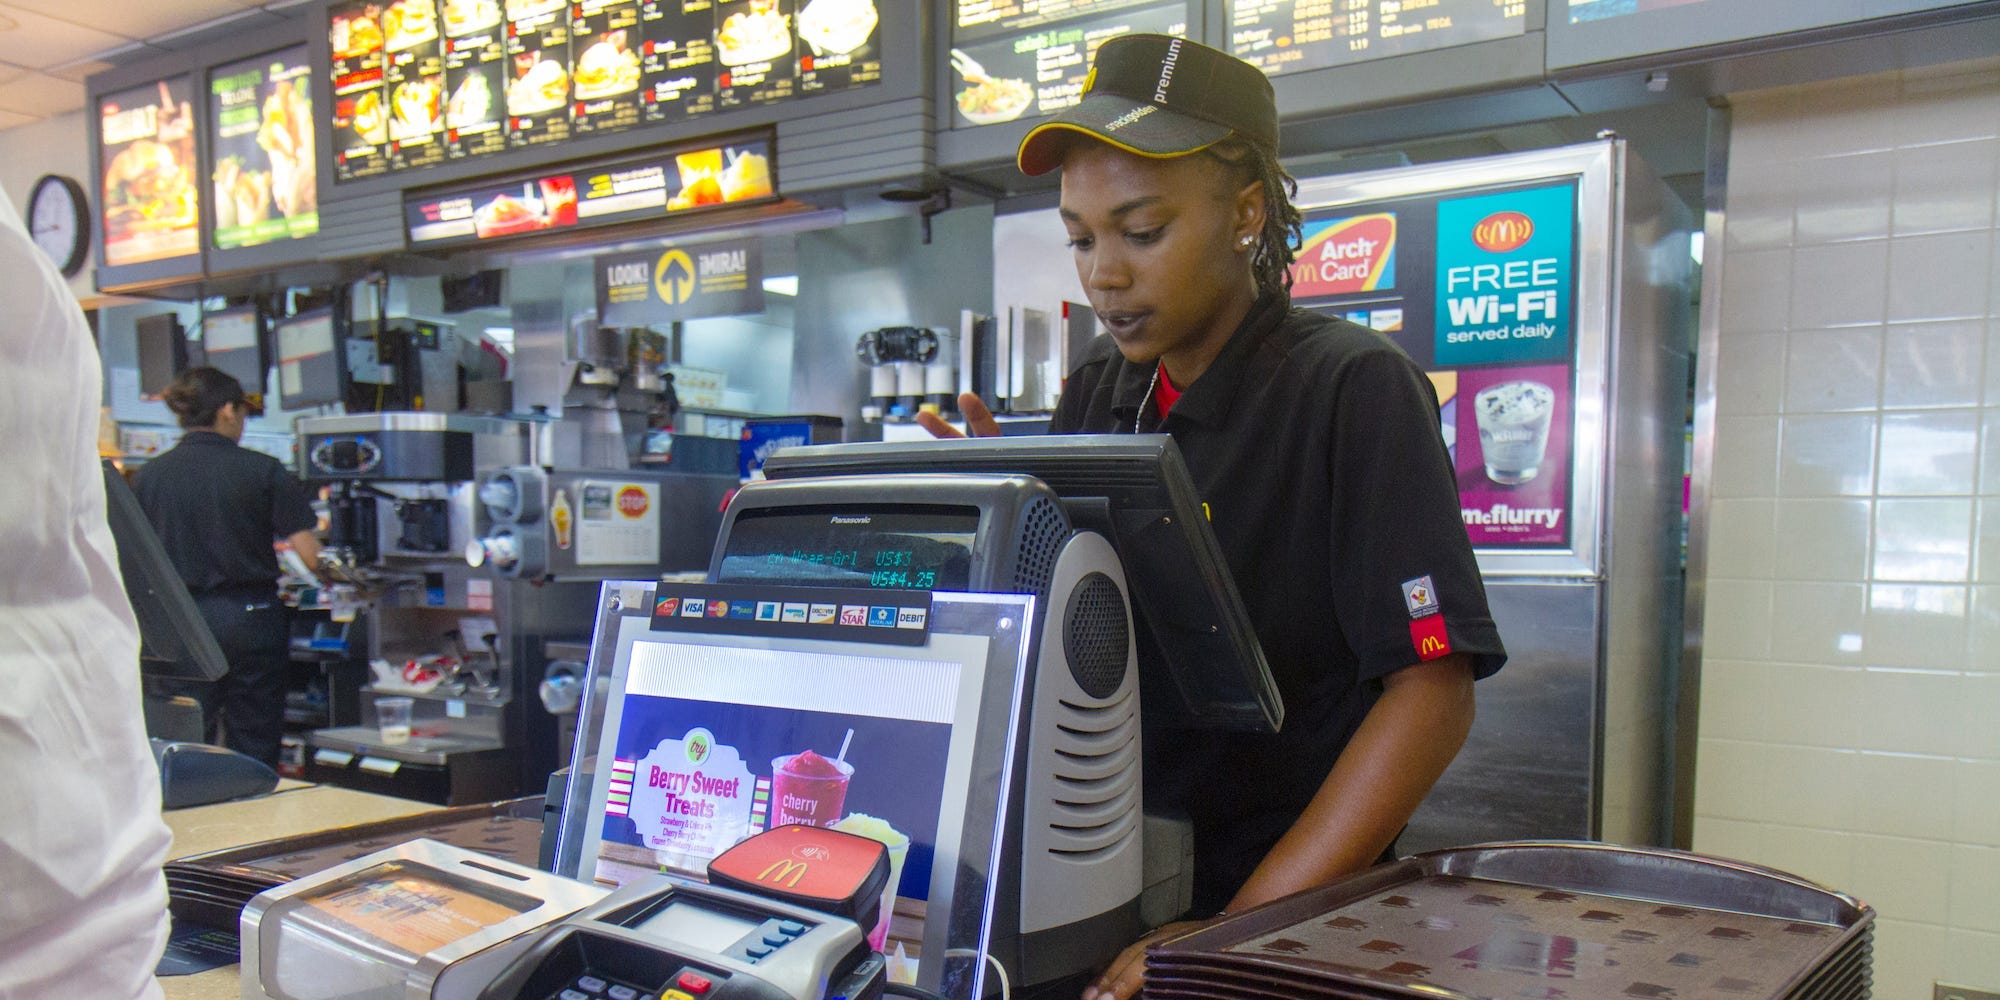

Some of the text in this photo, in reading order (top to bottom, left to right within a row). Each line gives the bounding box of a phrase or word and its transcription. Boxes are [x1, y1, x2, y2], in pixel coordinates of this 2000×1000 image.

[1154, 39, 1183, 104] premium
[1320, 236, 1373, 262] Arch
[699, 249, 747, 275] ¡MIRA!
[1320, 258, 1371, 282] Card
[607, 262, 649, 287] LOOK!
[1447, 257, 1558, 294] FREE
[1446, 289, 1557, 326] Wi-Fi
[1446, 322, 1556, 343] served daily
[620, 494, 646, 509] STOP
[830, 515, 871, 525] Panasonic
[870, 570, 936, 588] US$4.25
[685, 603, 703, 613] VISA
[899, 613, 925, 623] DEBIT
[841, 614, 865, 625] STAR
[690, 739, 707, 761] try
[648, 765, 740, 799] Berry Sweet
[665, 792, 715, 819] Treats
[782, 792, 818, 816] cherry
[660, 815, 684, 829] Strawberry
[780, 807, 816, 827] berry
[662, 827, 678, 839] Cherry
